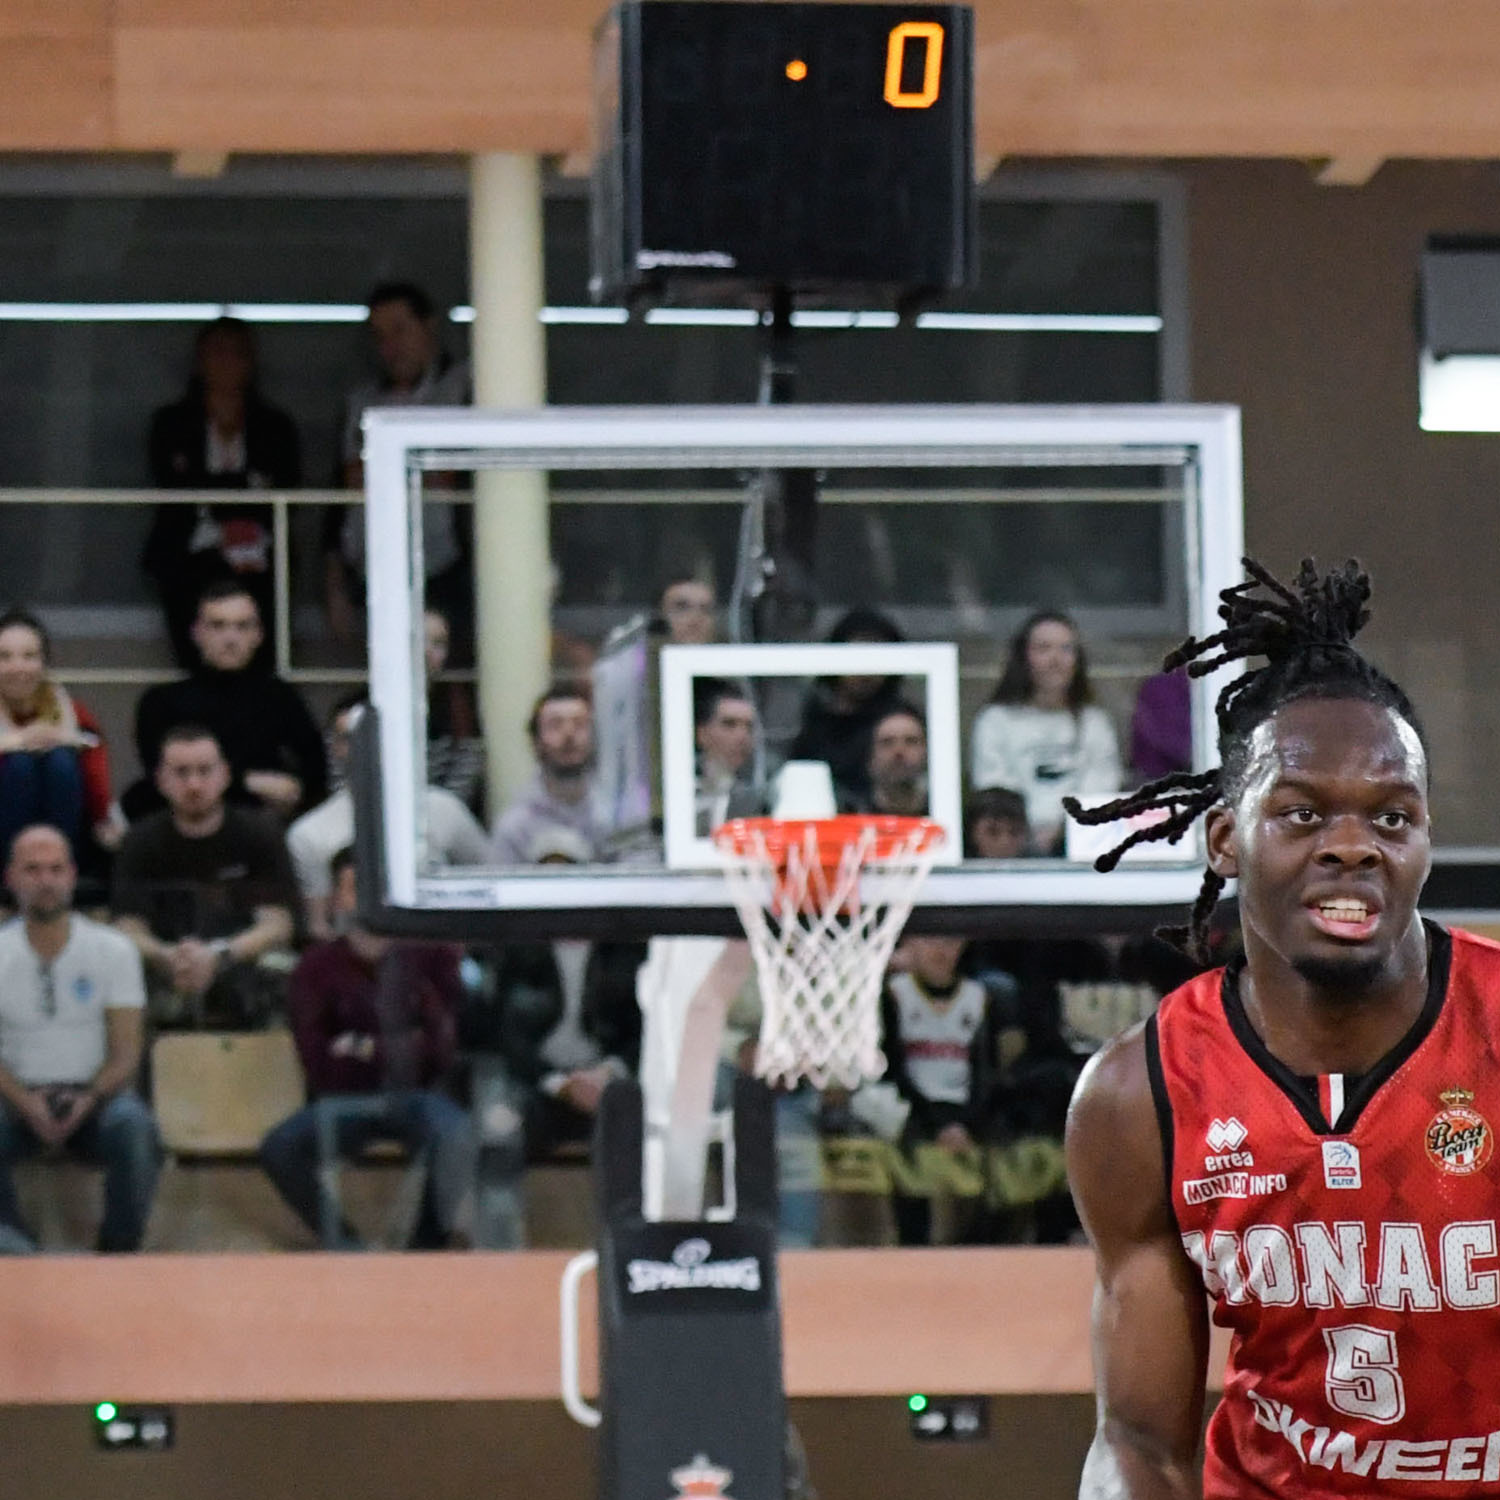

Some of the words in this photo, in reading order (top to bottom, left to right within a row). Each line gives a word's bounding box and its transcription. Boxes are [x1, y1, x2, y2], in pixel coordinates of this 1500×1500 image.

[884, 22, 945, 108] 0
[1186, 1174, 1249, 1204] MONACO
[1250, 1174, 1287, 1195] INFO
[1322, 1323, 1405, 1424] 5
